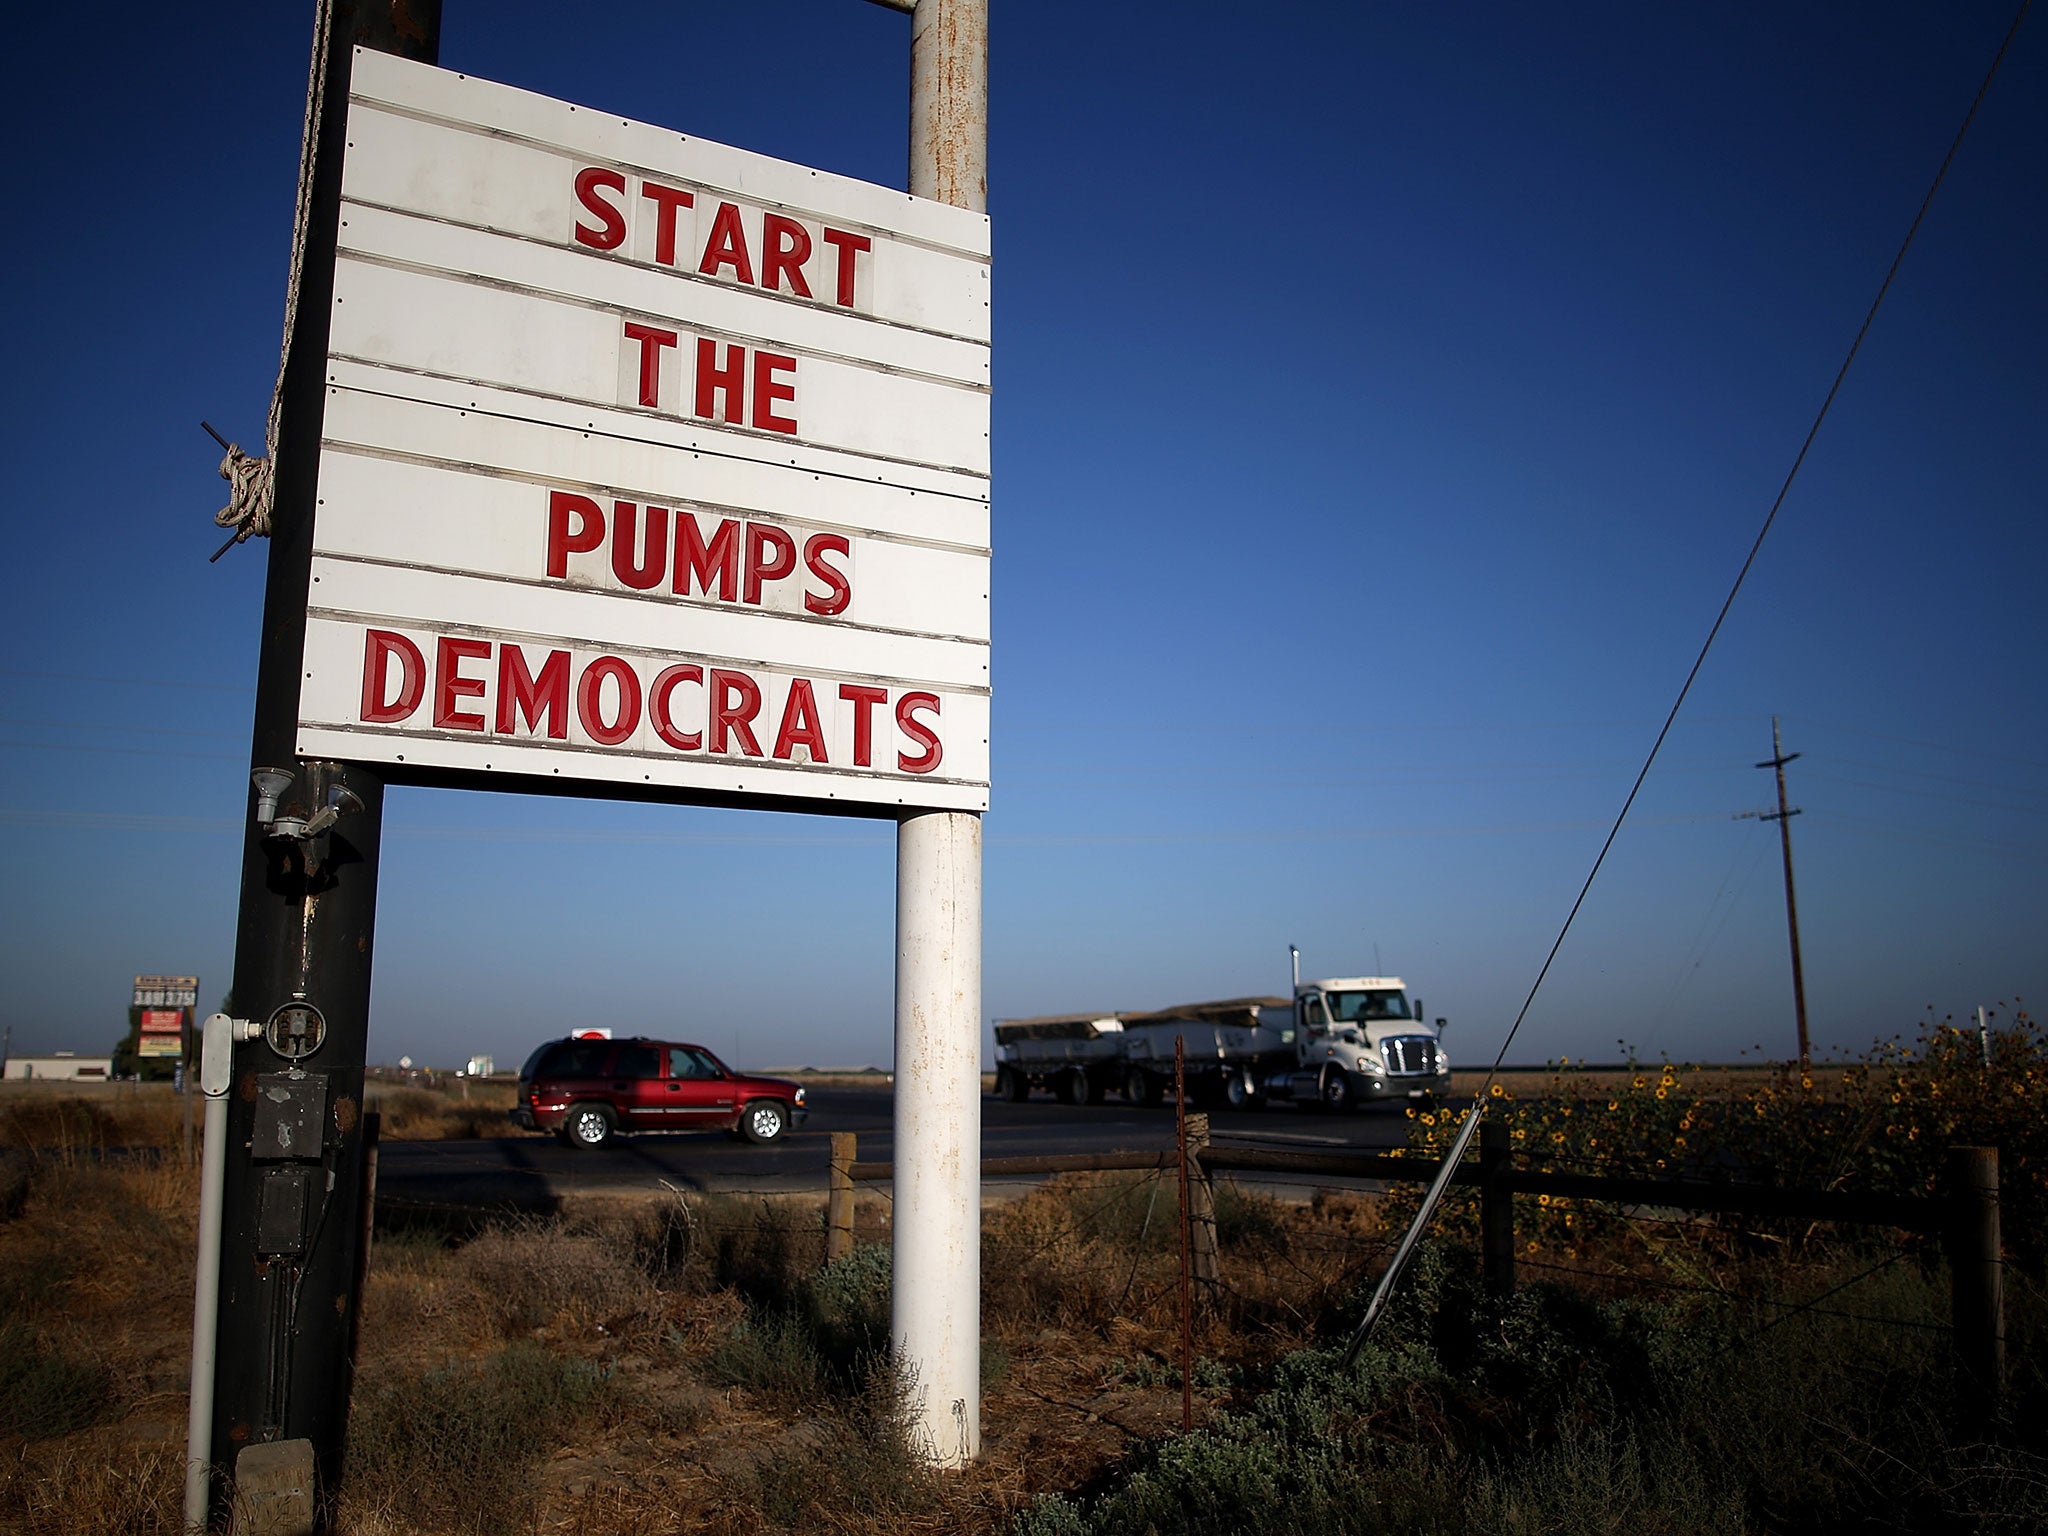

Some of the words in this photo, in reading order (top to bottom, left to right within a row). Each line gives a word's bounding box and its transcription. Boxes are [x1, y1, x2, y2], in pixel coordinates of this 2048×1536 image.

[576, 168, 872, 308] START
[624, 322, 798, 435] THE
[546, 490, 851, 616] PUMPS
[360, 629, 943, 774] DEMOCRATS
